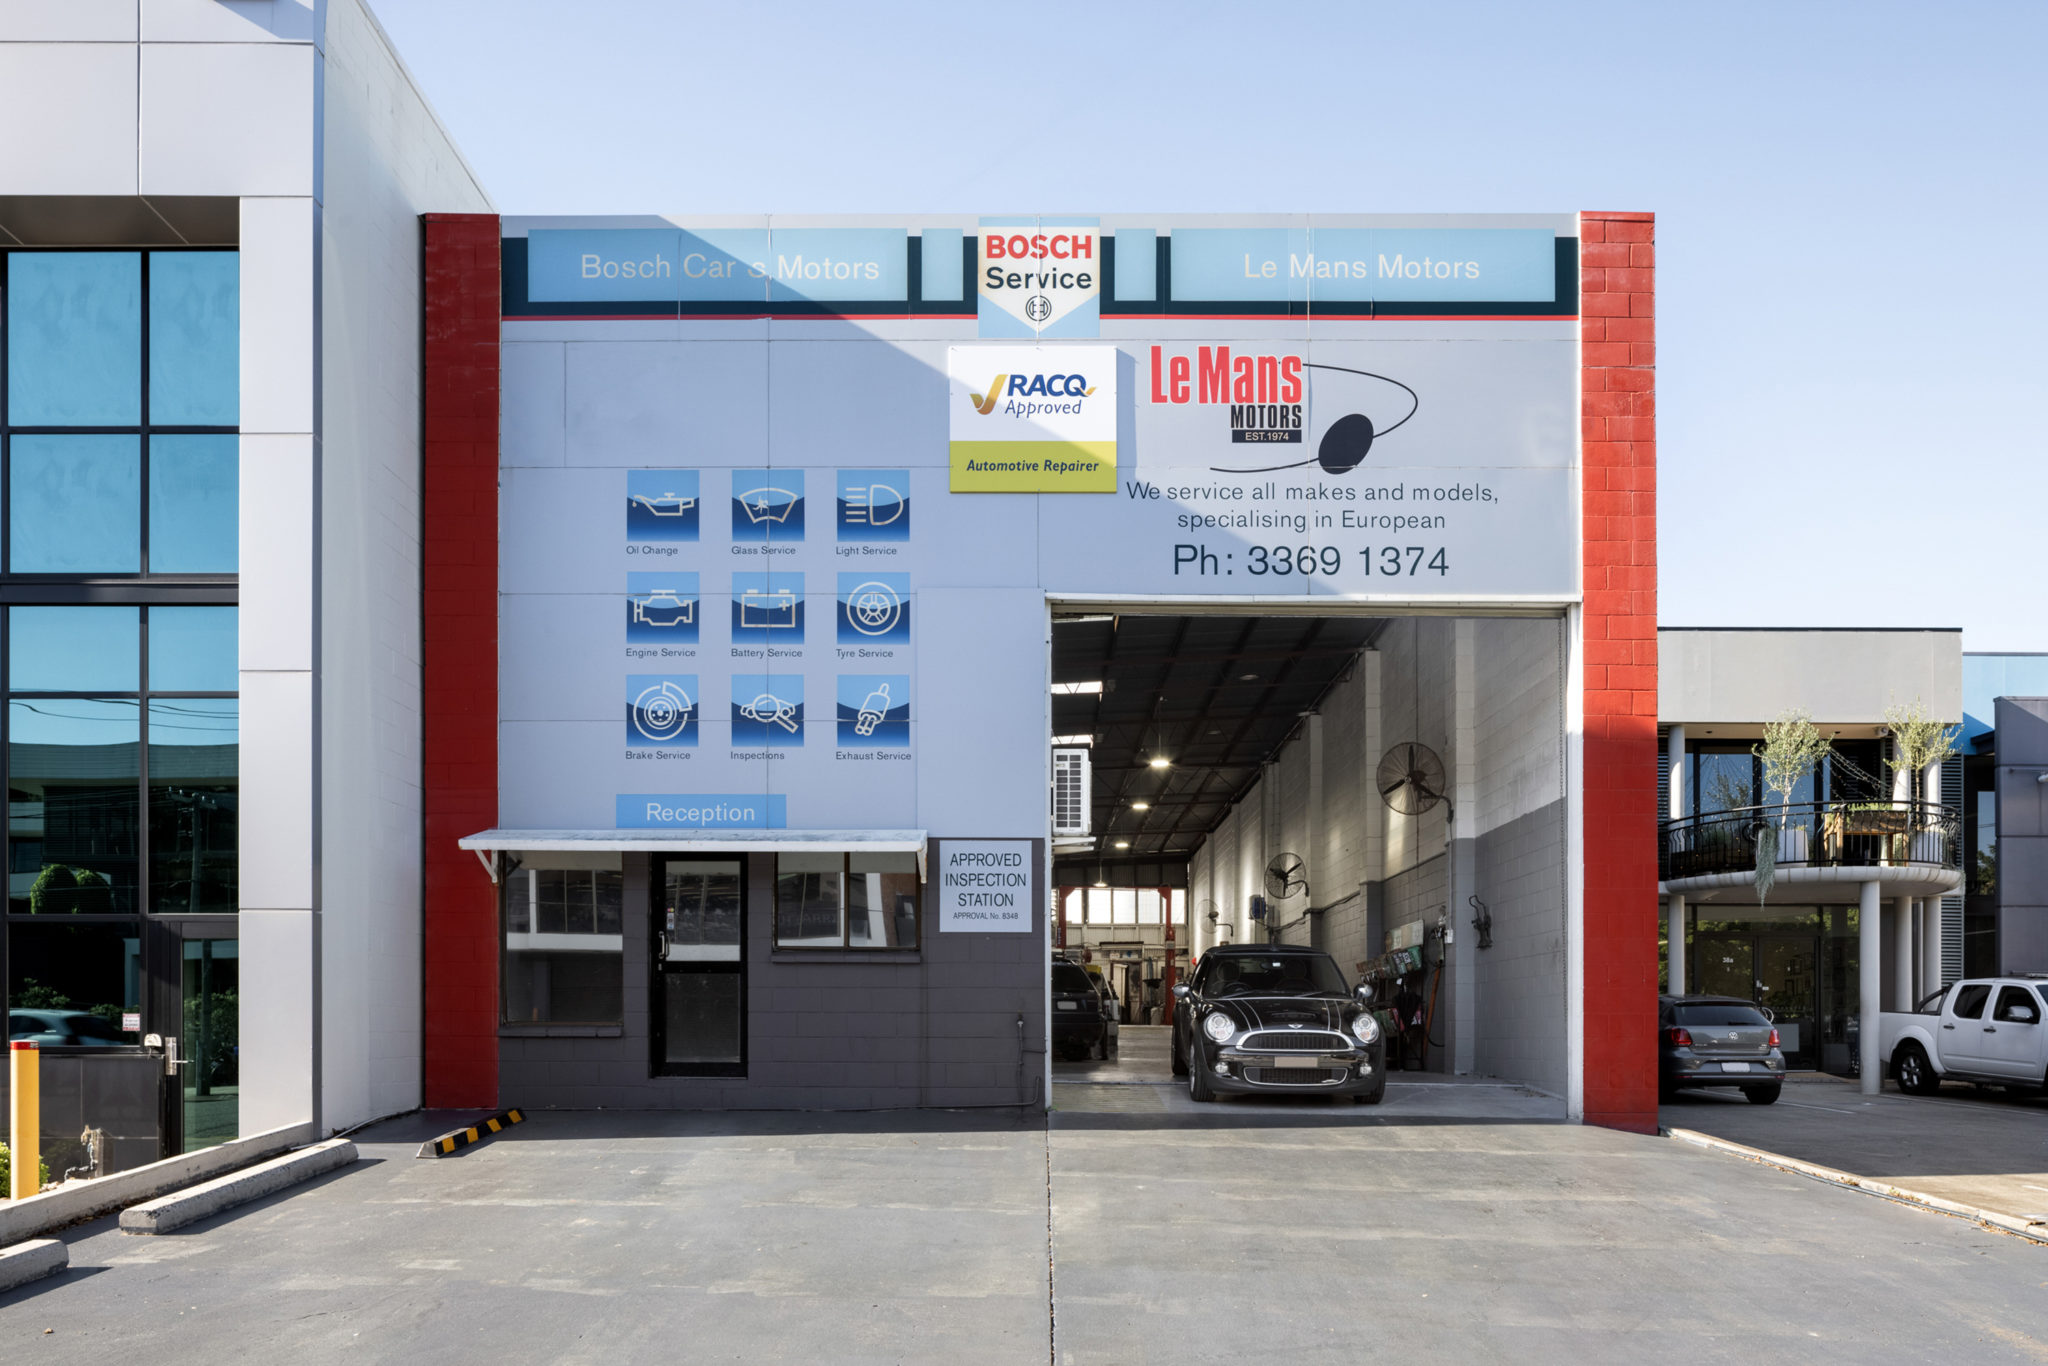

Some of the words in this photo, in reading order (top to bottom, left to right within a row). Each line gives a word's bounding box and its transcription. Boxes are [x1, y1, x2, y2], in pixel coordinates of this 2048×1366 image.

[986, 234, 1092, 260] BOSCH
[581, 254, 671, 279] Bosch
[684, 253, 736, 279] Car
[777, 254, 880, 280] Motors
[1244, 254, 1278, 279] Le
[1289, 254, 1368, 279] Mans
[1378, 254, 1480, 279] Motors
[985, 267, 1092, 290] Service
[1007, 374, 1088, 398] RACQ
[1004, 400, 1082, 418] Approved
[1230, 404, 1302, 429] MOTORS
[1245, 432, 1289, 441] EST.1974
[966, 459, 1041, 472] Automotive
[1044, 459, 1100, 475] Repairer
[1126, 481, 1160, 500] We
[1167, 481, 1244, 500] service
[1252, 482, 1276, 500] all
[1286, 482, 1356, 501] makes
[1364, 482, 1405, 501] and
[1412, 482, 1498, 504] models,
[1177, 509, 1306, 534] specialising
[1315, 510, 1332, 528] in
[1342, 510, 1445, 534] European
[626, 546, 639, 555] Oil
[642, 546, 679, 557] Change
[731, 546, 758, 555] Glass
[761, 546, 796, 555] Service
[835, 546, 859, 557] Light
[862, 546, 897, 556] Service
[1174, 544, 1233, 576] Ph:
[1247, 545, 1341, 576] 3369
[1358, 546, 1450, 577] 1374
[625, 648, 658, 659] Engine
[661, 648, 696, 657] Service
[731, 648, 765, 659] Battery
[767, 648, 803, 658] Service
[836, 648, 856, 660] Tyre
[858, 648, 894, 658] Service
[625, 751, 653, 760] Brake
[655, 751, 691, 760] Service
[730, 751, 785, 762] Inspections
[835, 751, 873, 761] Exhaust
[876, 751, 912, 761] Service
[646, 803, 755, 825] Reception
[949, 852, 1022, 867] APPROVED
[945, 872, 1027, 887] INSPECTION
[957, 892, 1014, 907] STATION
[953, 912, 988, 920] APPROVAL
